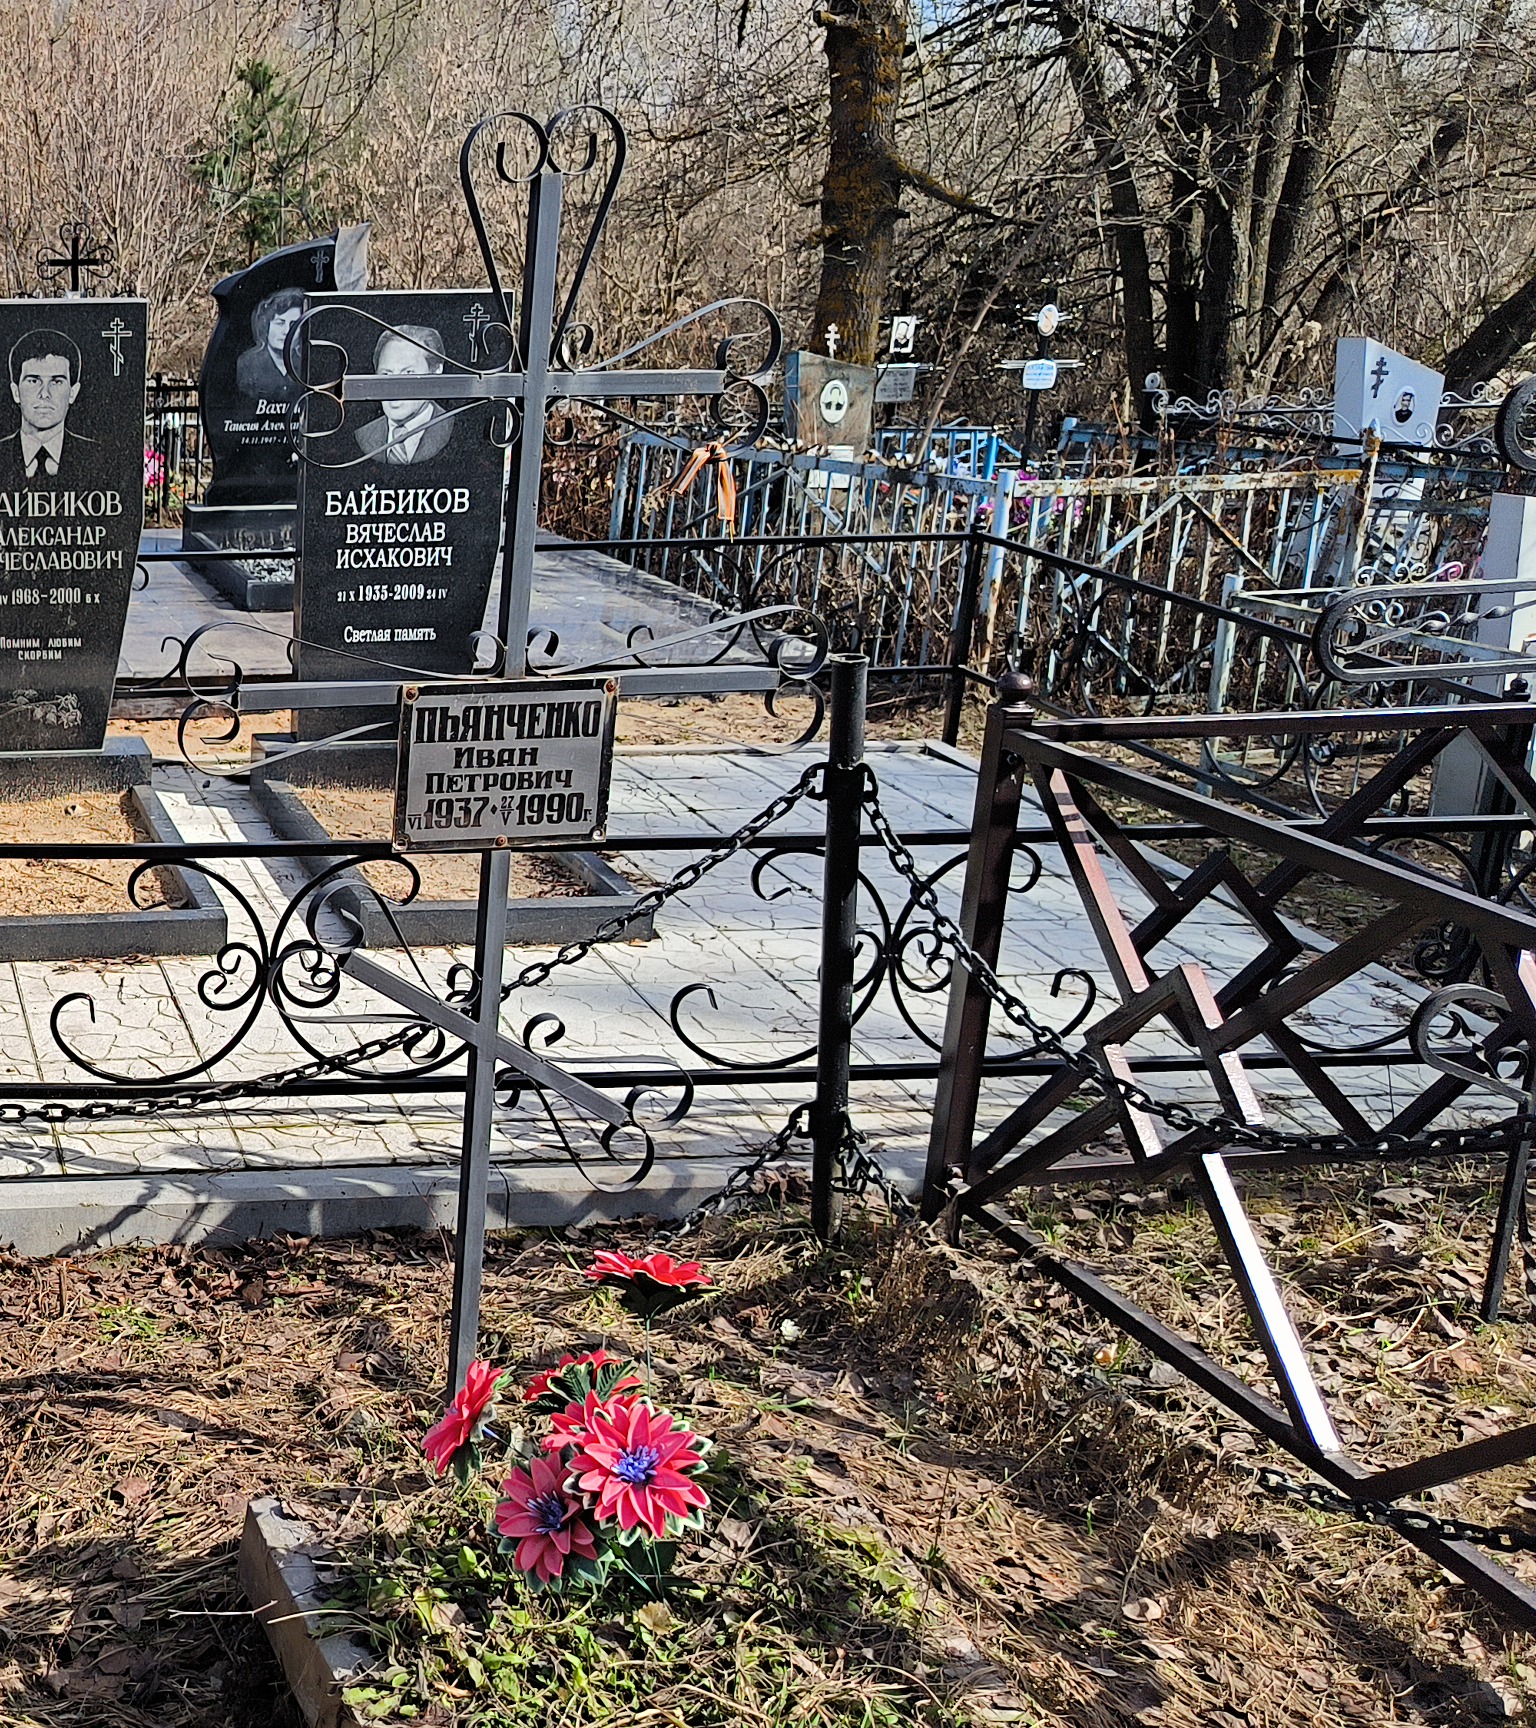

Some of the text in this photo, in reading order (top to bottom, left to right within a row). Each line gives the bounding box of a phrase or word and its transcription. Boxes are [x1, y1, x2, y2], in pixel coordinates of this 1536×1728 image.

[325, 484, 470, 516] БАЙБИКОВ
[345, 522, 446, 544] ВЯЧЕСЛАВ
[336, 547, 453, 569] ИСХАКОВИЧ
[344, 626, 437, 643] Светлая память
[414, 700, 602, 744] ПЬЯНЧЕНКО
[424, 797, 489, 830] 1937
[516, 792, 584, 826] 1990
